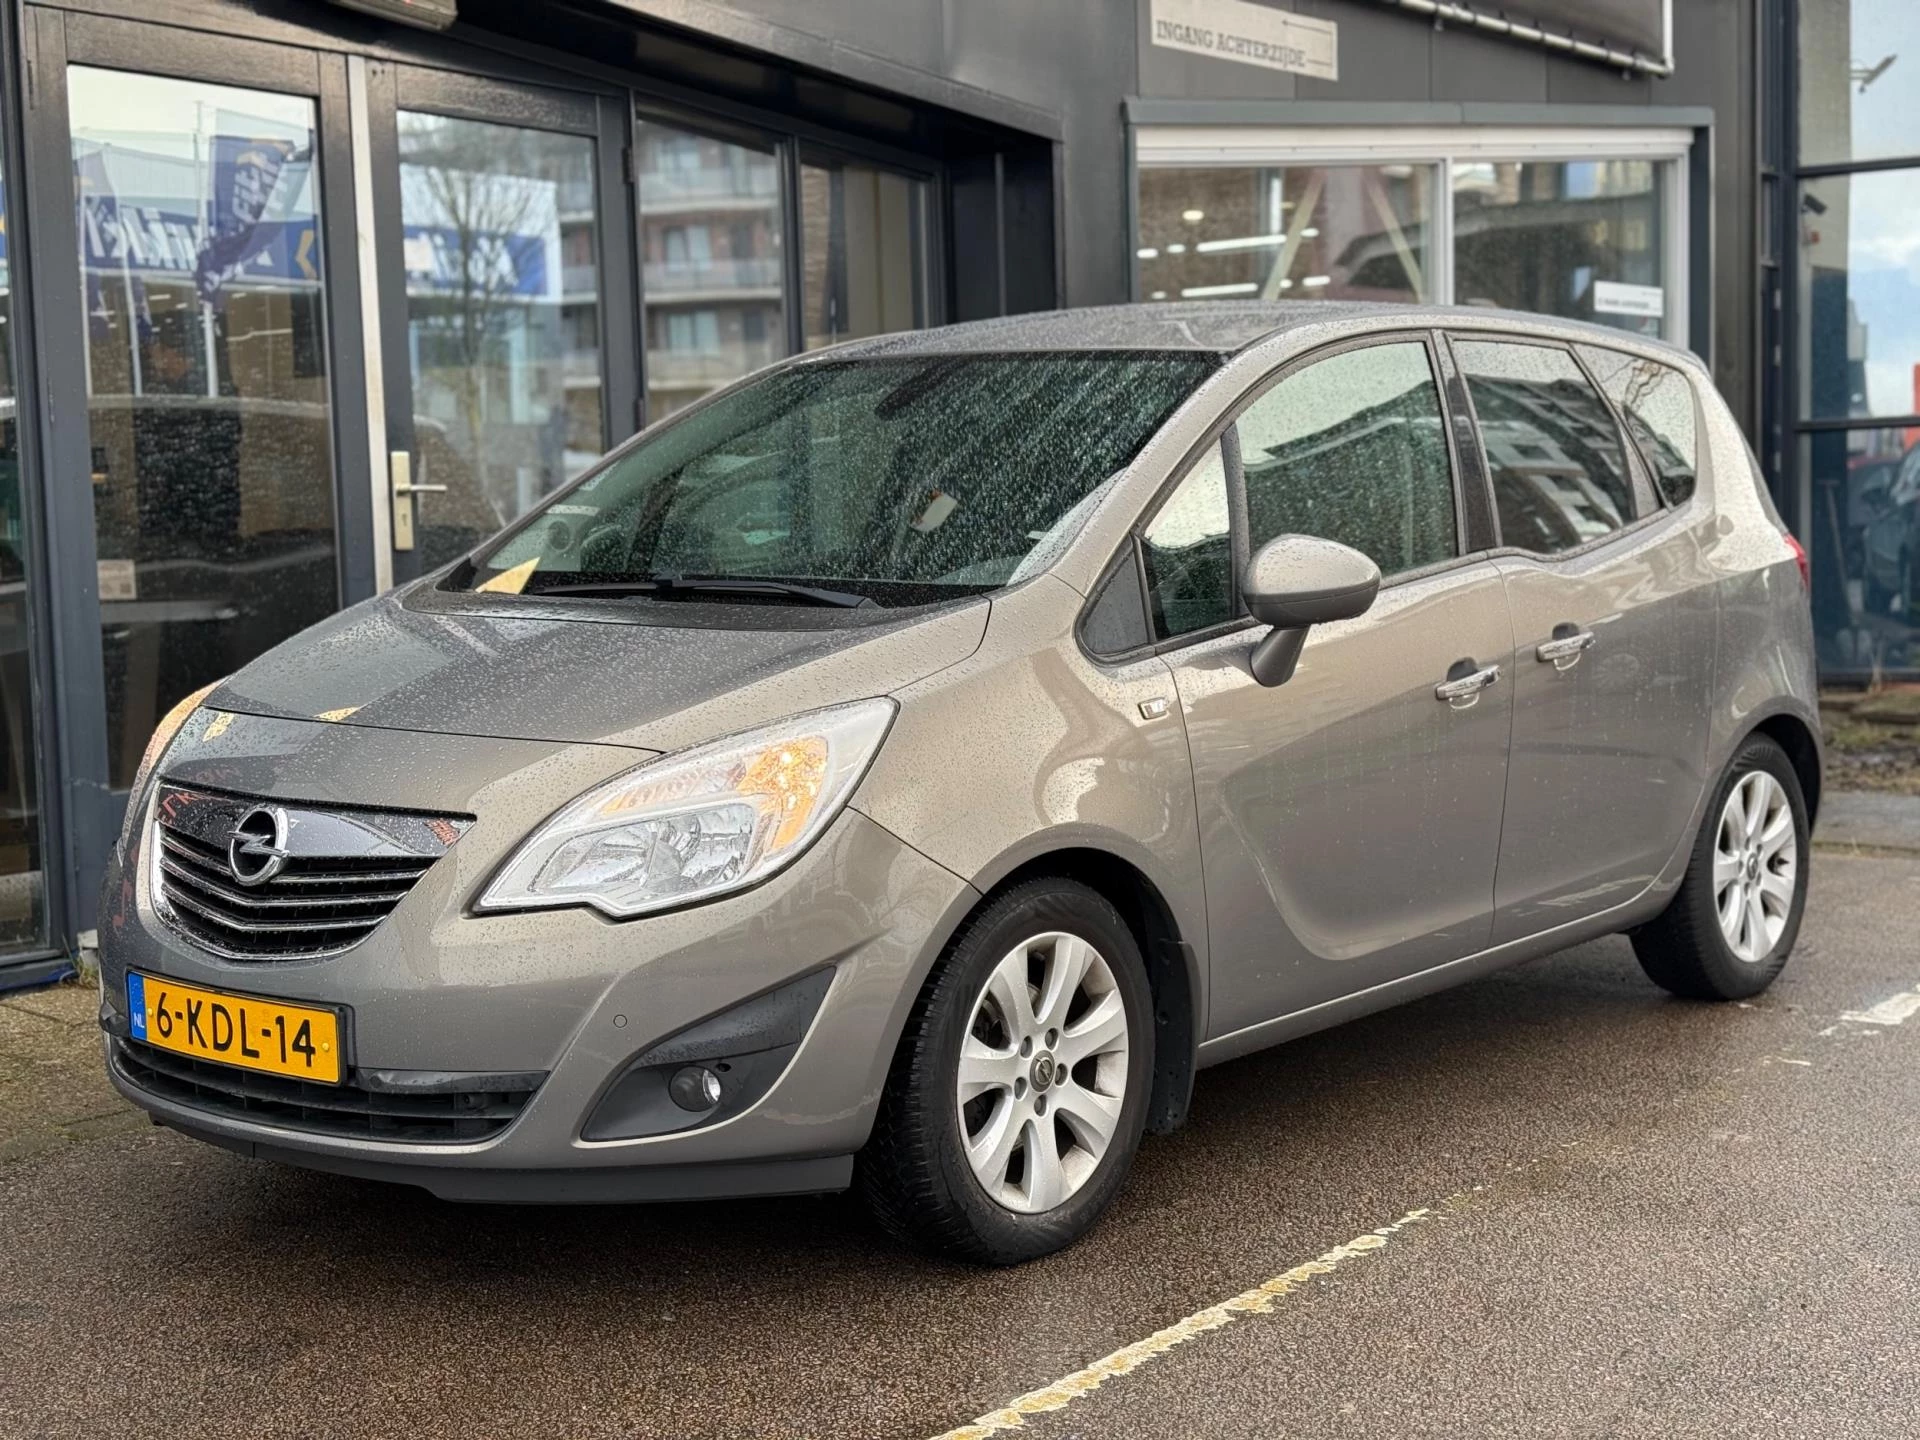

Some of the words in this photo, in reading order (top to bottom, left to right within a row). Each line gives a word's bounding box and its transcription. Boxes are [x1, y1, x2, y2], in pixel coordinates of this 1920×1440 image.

[1156, 19, 1213, 48] INGANG
[1216, 32, 1306, 68] ACHTERZIJDE
[133, 1012, 146, 1029] NL
[156, 991, 317, 1068] 6-KDL-14
